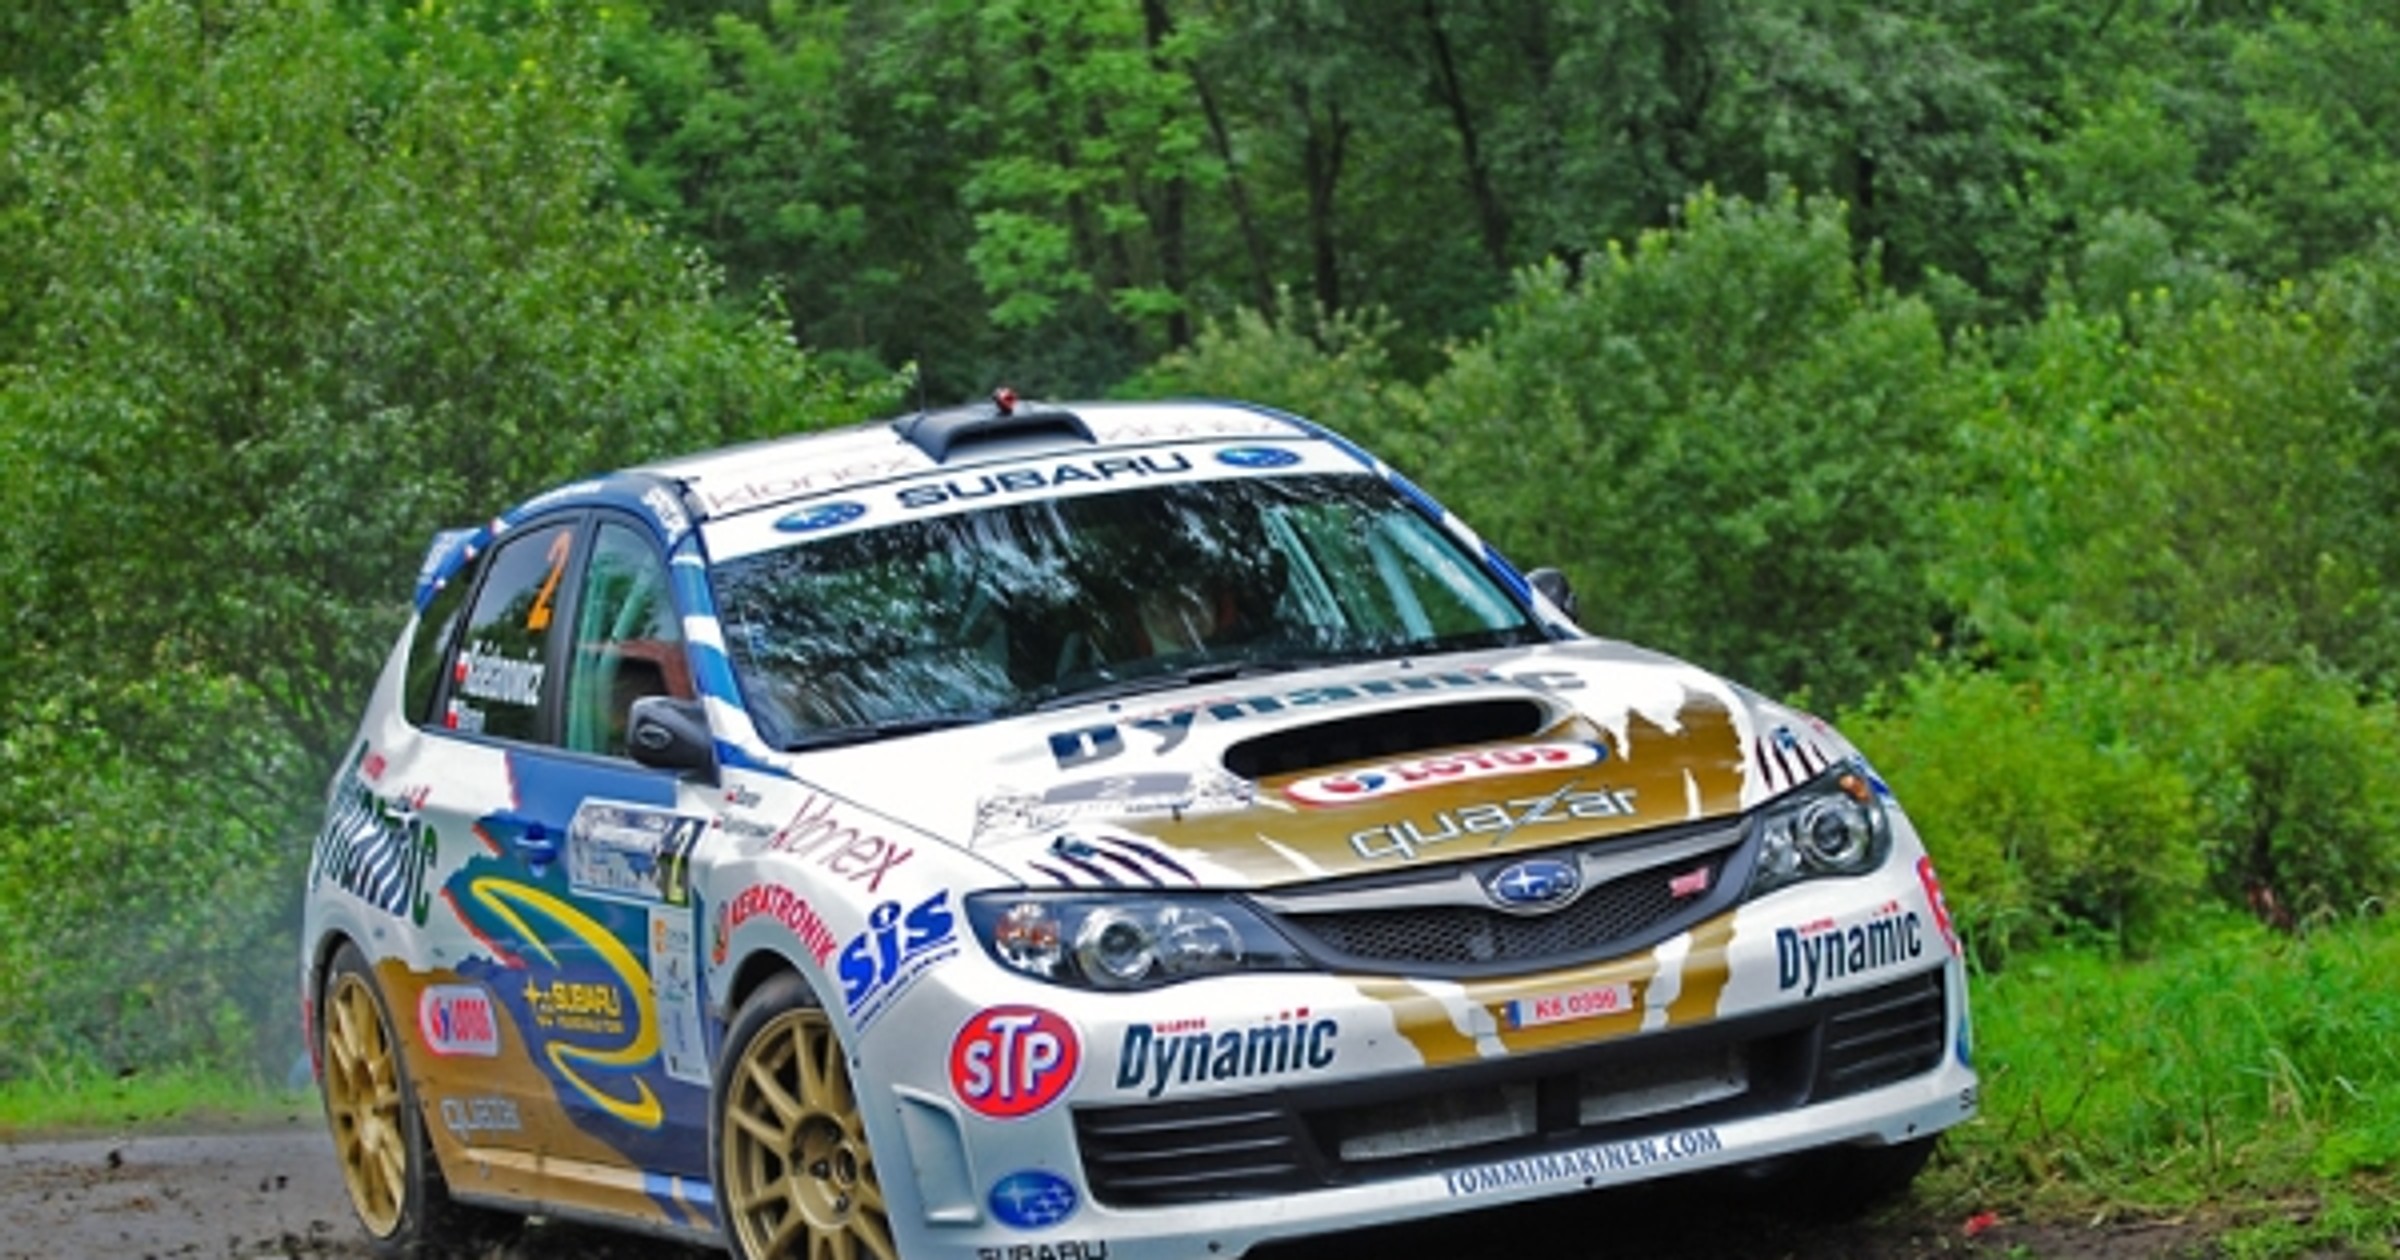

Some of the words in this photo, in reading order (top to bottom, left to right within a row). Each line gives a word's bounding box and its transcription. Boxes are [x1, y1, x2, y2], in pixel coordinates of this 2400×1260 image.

[896, 452, 1192, 508] SUBARU
[527, 529, 572, 630] 2
[1390, 747, 1569, 782] LOTOS
[1350, 778, 1637, 859] quazar
[1775, 900, 1922, 998] Dynamic
[963, 1013, 1063, 1102] STP
[1116, 1007, 1338, 1098] Dynamic
[1444, 1127, 1722, 1197] TOMMIMAKINEN.COM
